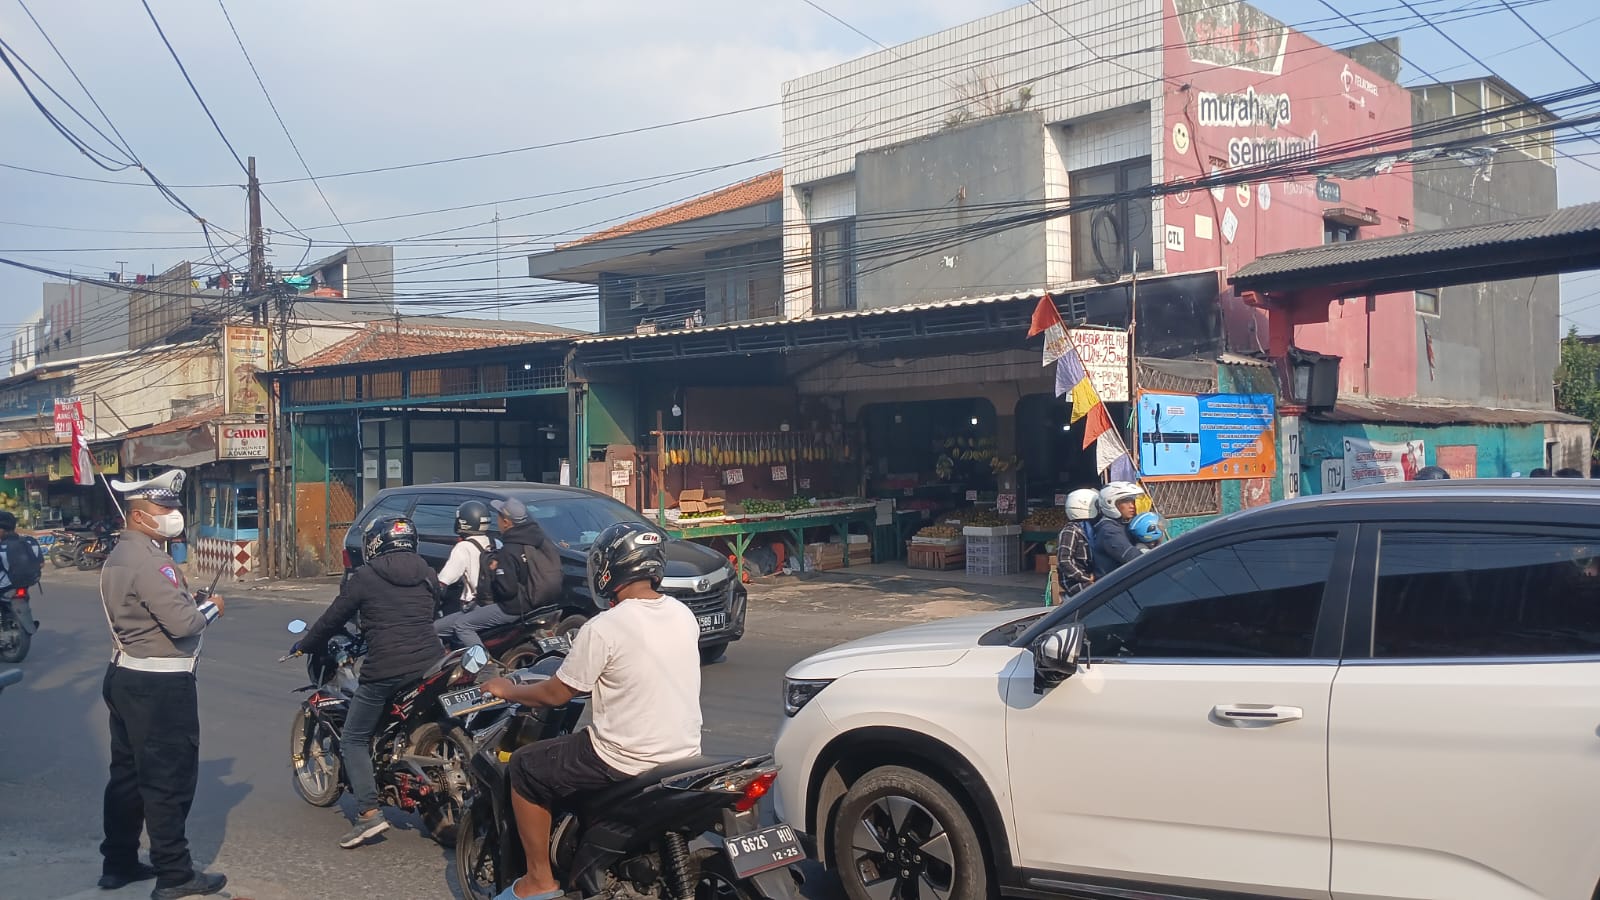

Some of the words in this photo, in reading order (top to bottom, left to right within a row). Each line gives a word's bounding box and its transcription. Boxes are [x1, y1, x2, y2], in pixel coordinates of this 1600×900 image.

[1168, 230, 1181, 245] CTL
[224, 428, 266, 439] Canon
[1288, 435, 1297, 455] 17
[1289, 473, 1299, 493] 08
[642, 534, 658, 542] GM
[728, 842, 740, 857] D
[741, 834, 769, 853] 6626
[776, 828, 792, 843] HU
